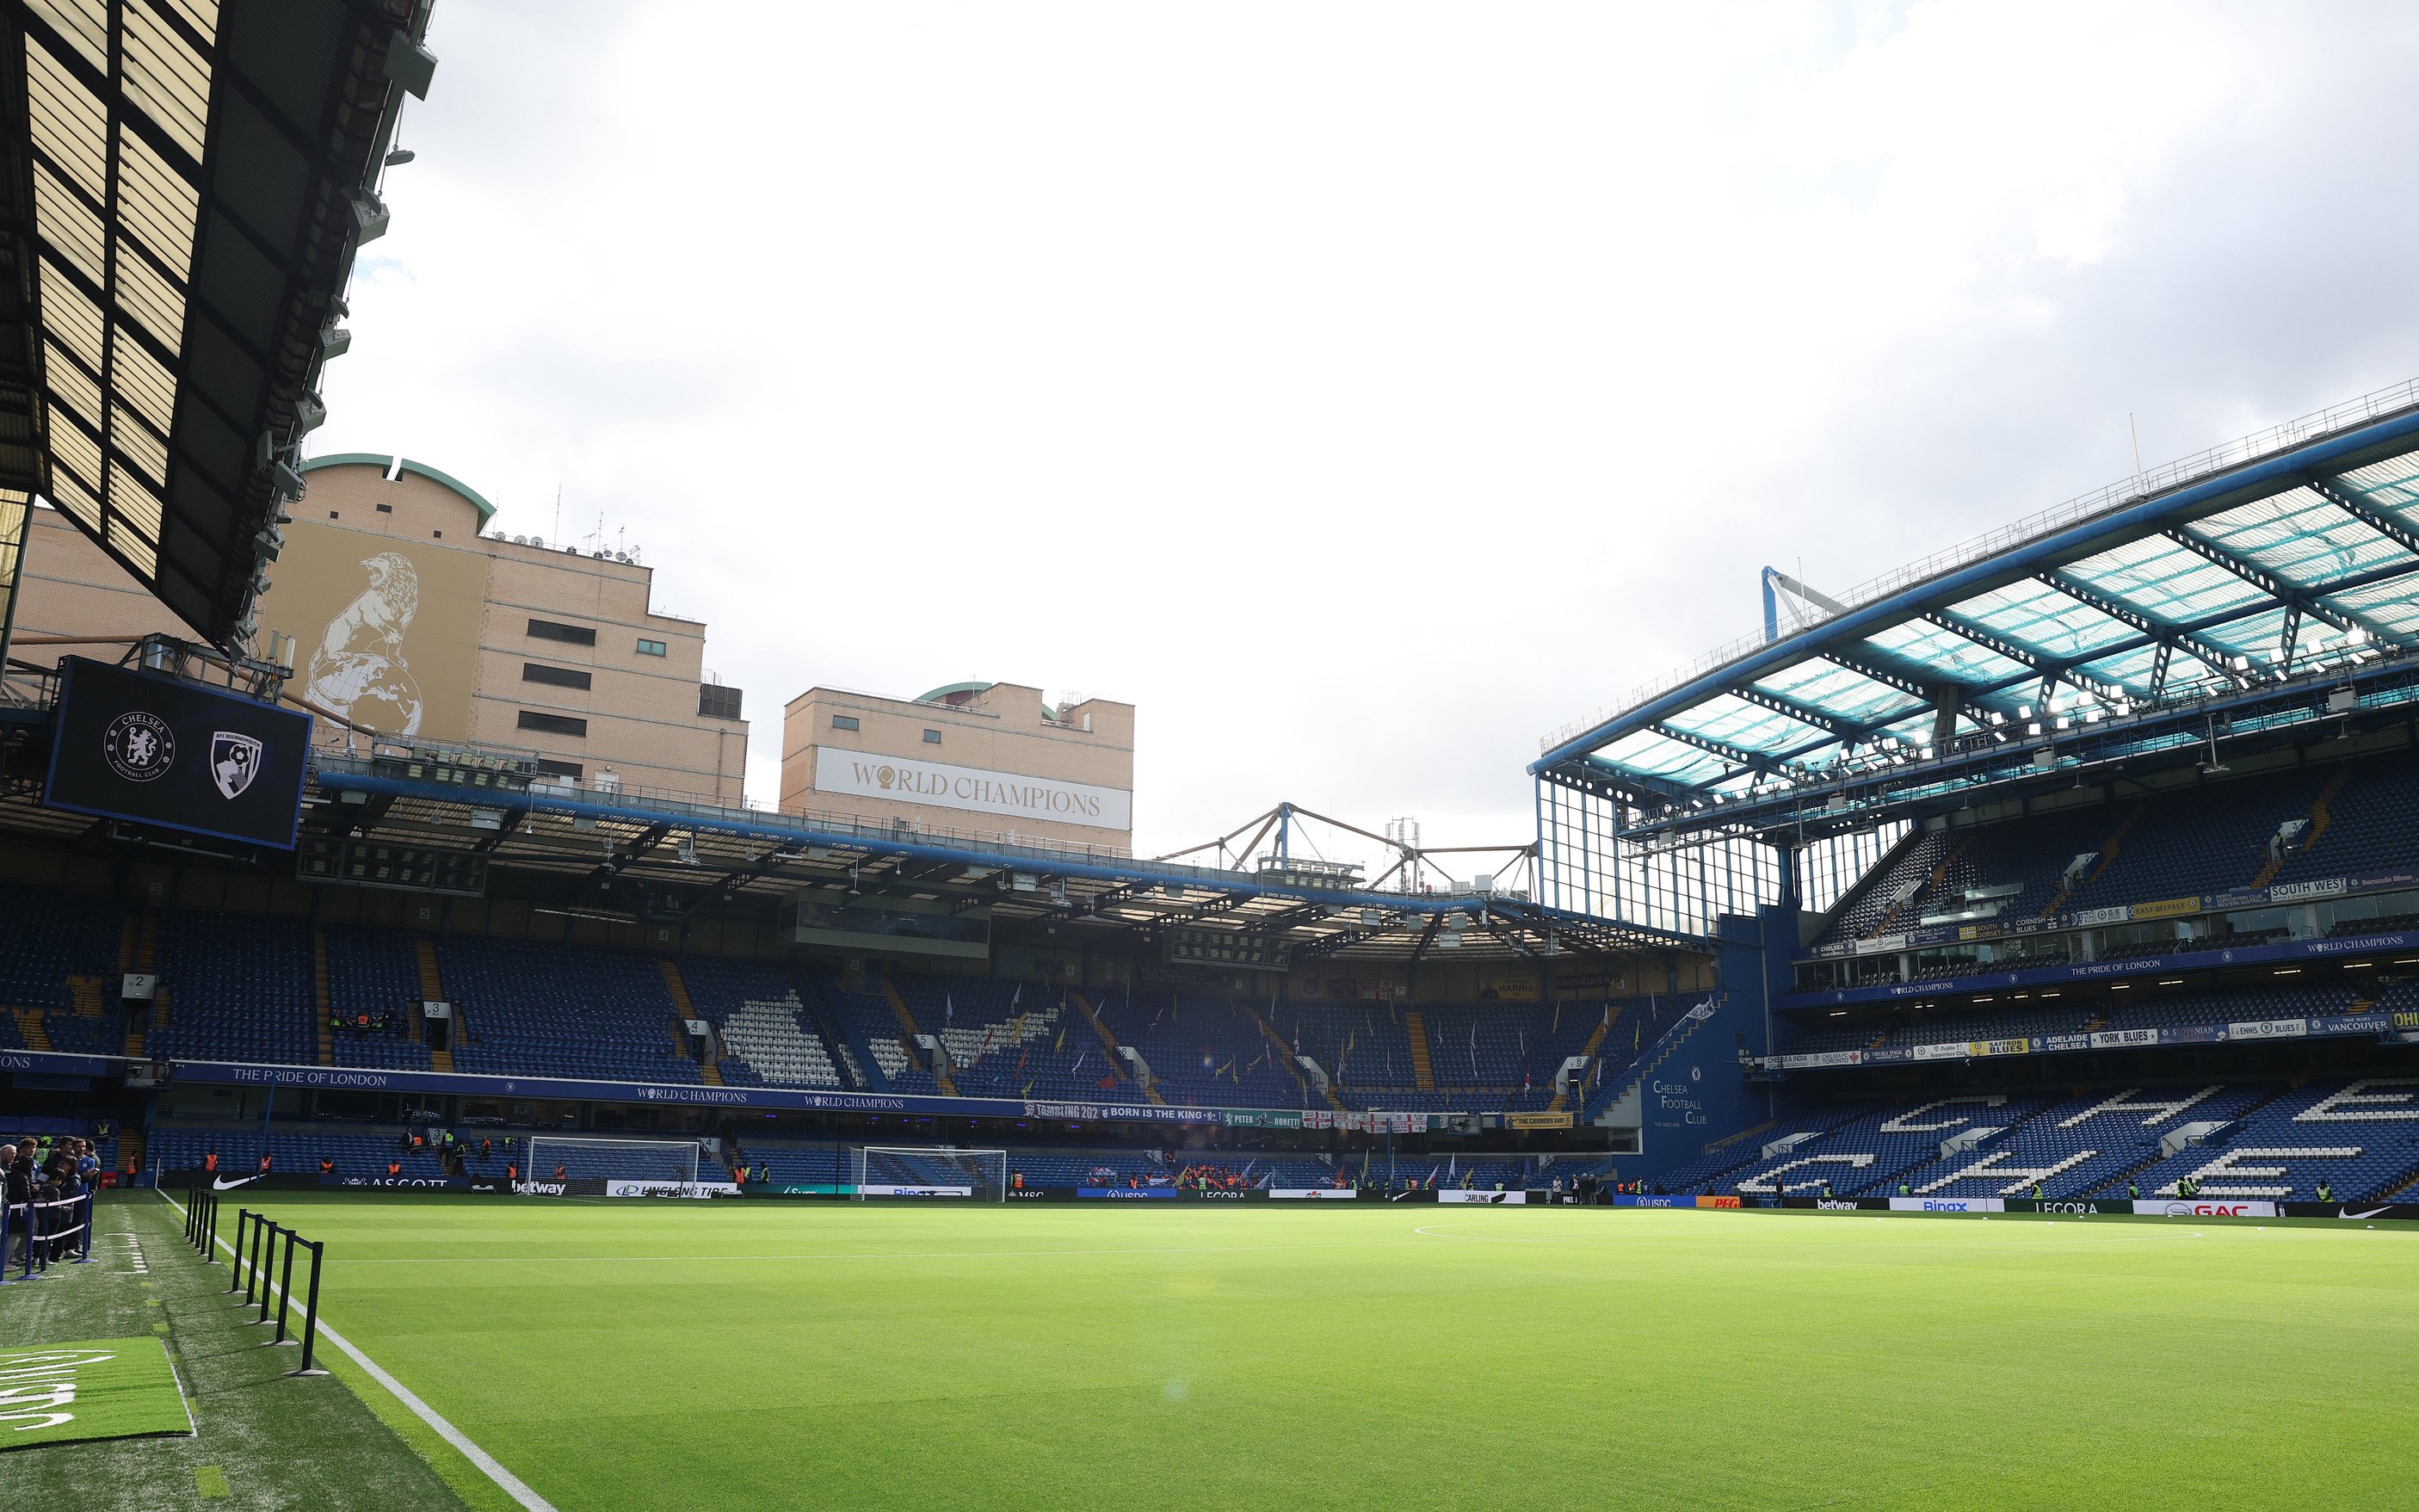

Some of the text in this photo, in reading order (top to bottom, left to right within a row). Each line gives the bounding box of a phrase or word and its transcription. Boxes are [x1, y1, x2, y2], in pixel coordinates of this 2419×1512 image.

[121, 714, 164, 733] CHELSEA
[225, 734, 261, 748] BOURNEMOUTH
[114, 760, 160, 778] FOOTBALL CLUB
[852, 762, 1101, 818] WORLD CHAMPIONS
[153, 885, 159, 894] 2
[2272, 879, 2345, 896] SOUTH WEST
[2155, 903, 2185, 912] BELFAST
[422, 910, 428, 919] 3
[2015, 916, 2046, 927] CORNISH
[1977, 923, 1997, 932] SOUTH
[2016, 925, 2037, 934] BLUES
[661, 931, 667, 940] 4
[1977, 929, 2001, 938] DORSET
[2307, 935, 2404, 953] WORLD CHAMPIONS
[2070, 960, 2161, 976] THE PRIDE OF LONDON
[136, 976, 144, 986] 2
[1891, 982, 1953, 996] WORLD CHAMPIONS
[432, 1003, 440, 1013] 3
[691, 1021, 697, 1030] 4
[2172, 1026, 2213, 1036] SLOVENIAN
[2240, 1024, 2295, 1035] ENNIS BLUES
[2328, 1021, 2388, 1033] VANCOUVER
[921, 1035, 926, 1044] 5
[2046, 1034, 2089, 1044] ADELAIDE
[2099, 1030, 2148, 1043] YORK BLUES
[1990, 1045, 2023, 1053] BLUES
[2048, 1042, 2088, 1051] CHELSEA
[1577, 1057, 1582, 1065] 8
[232, 1068, 387, 1086] THE PRIDE OF LONDON
[1653, 1080, 1688, 1095] CHELSEA
[637, 1088, 747, 1103] WORLD CHAMPIONS
[805, 1095, 904, 1109] WORLD CHAMPIONS
[1661, 1095, 1702, 1110] FOOTBALL
[1037, 1104, 1079, 1118] TAMBLING
[1111, 1107, 1202, 1120] BORN IS THE KING
[1234, 1115, 1253, 1124] PETER
[1685, 1111, 1707, 1125] CLUB
[511, 1180, 565, 1194] betway
[1648, 1199, 1671, 1207] USDC
[1817, 1199, 1858, 1210] betway
[1923, 1200, 1967, 1212] Binax
[2035, 1202, 2098, 1214] LEGORA
[2194, 1205, 2248, 1216] GAC
